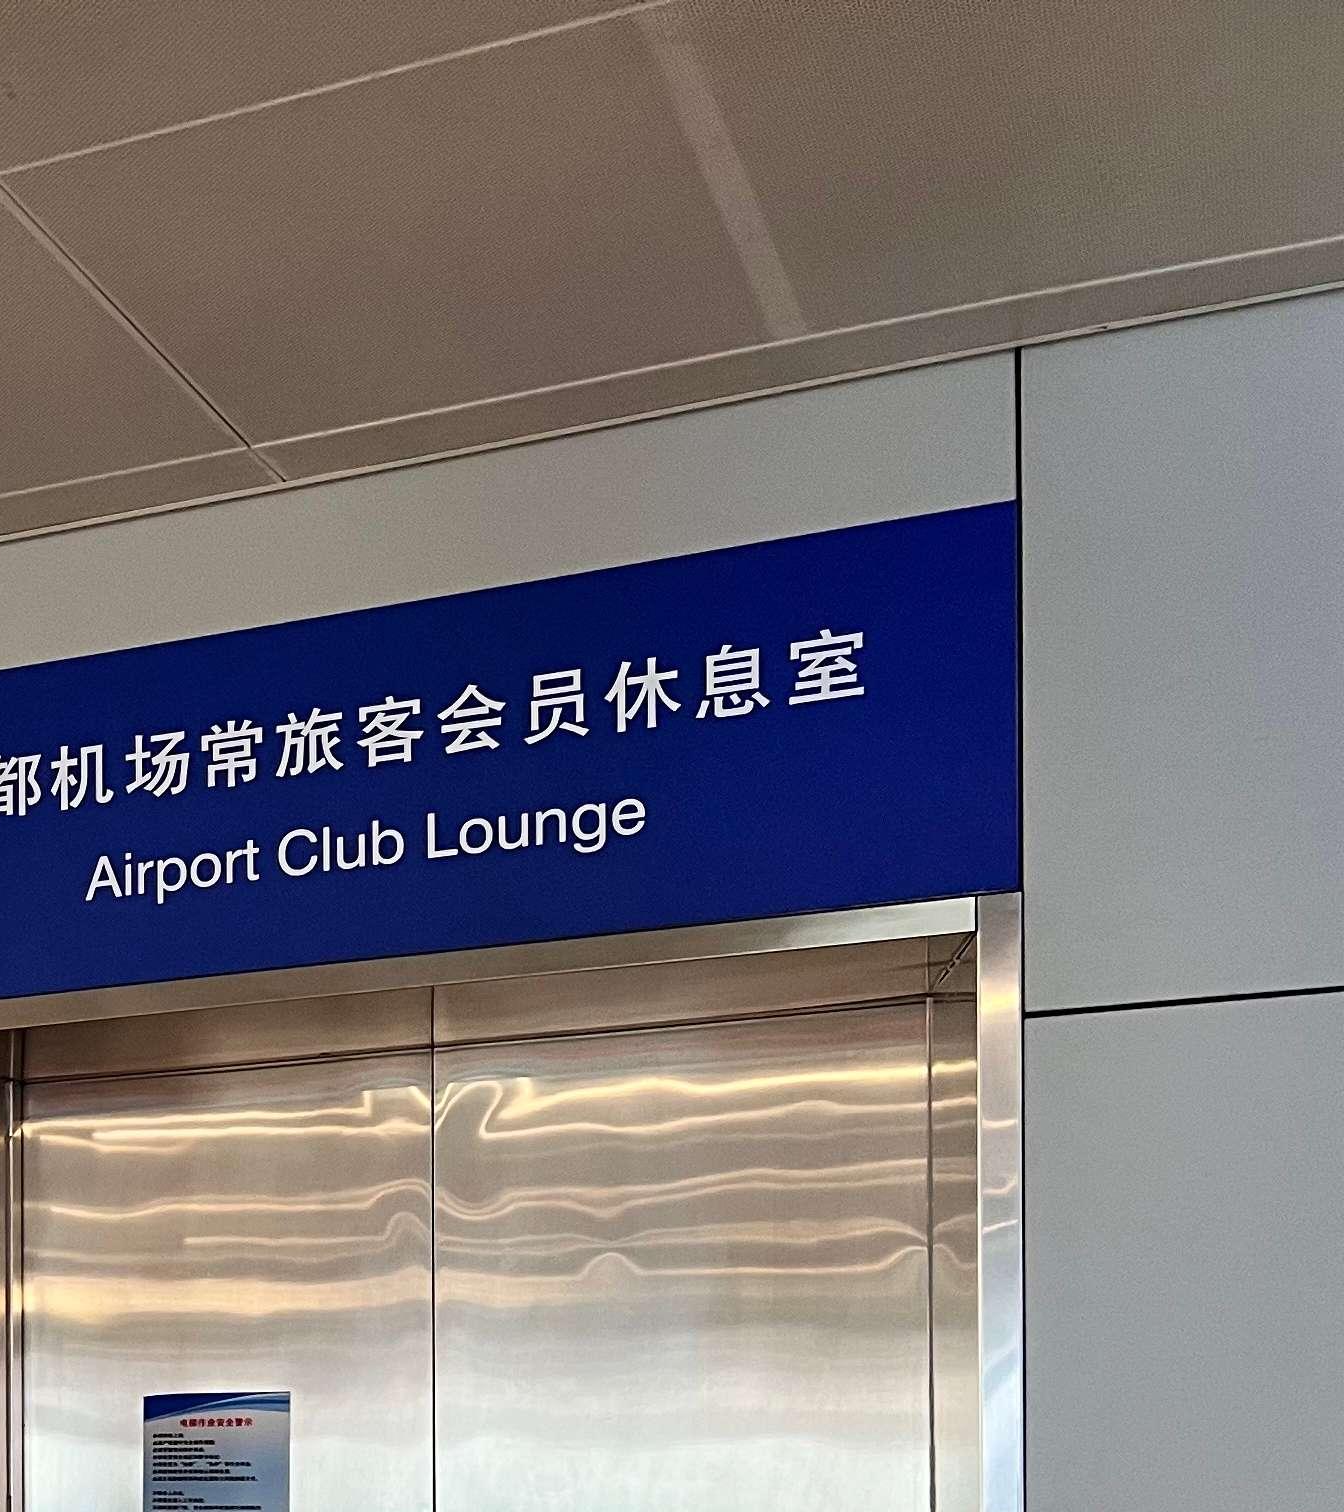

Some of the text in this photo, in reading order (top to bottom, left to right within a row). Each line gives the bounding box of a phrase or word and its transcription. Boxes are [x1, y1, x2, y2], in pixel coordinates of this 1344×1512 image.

[85, 794, 648, 904] Airport Club Lounge
